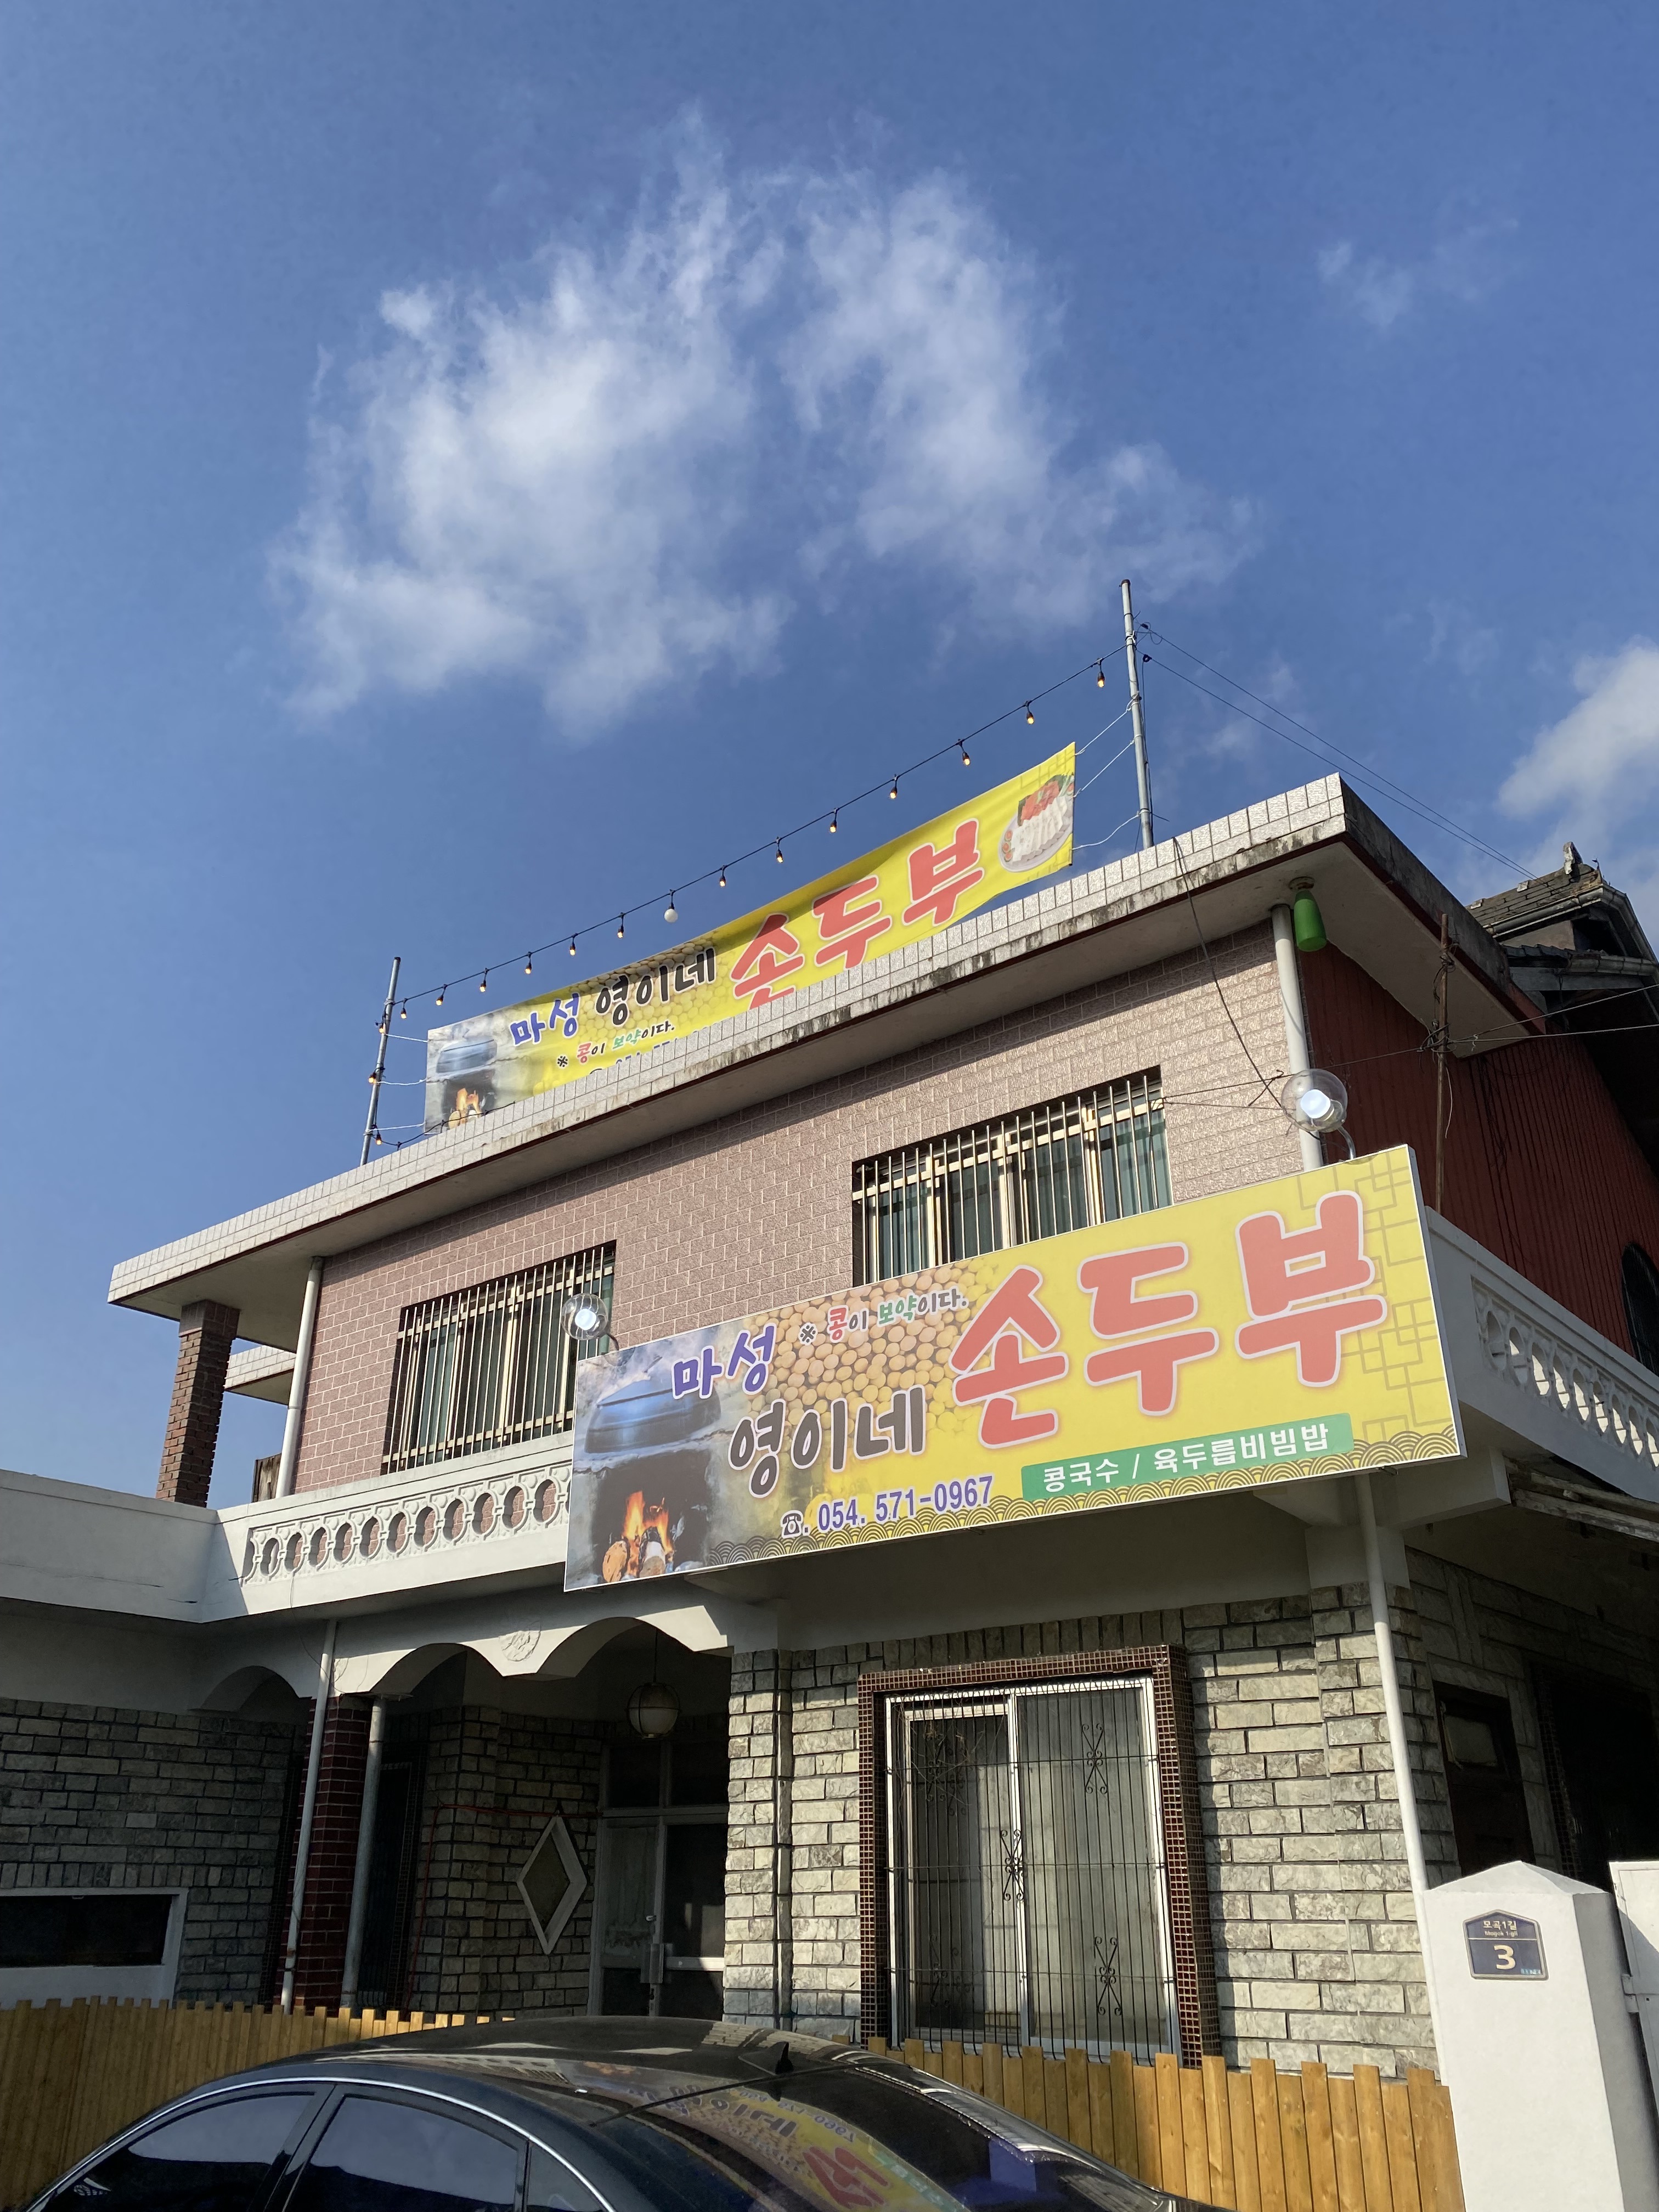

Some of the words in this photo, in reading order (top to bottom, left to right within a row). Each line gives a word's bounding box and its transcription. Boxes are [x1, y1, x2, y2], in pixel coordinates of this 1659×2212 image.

[510, 997, 579, 1046] 마성
[595, 947, 715, 1026] 영이네
[731, 820, 984, 1010] 손두부
[577, 1043, 605, 1063] 콩이
[613, 1021, 674, 1049] 보약이다.
[730, 1387, 924, 1496] 영이네
[953, 1192, 1386, 1447] 손두부
[828, 1307, 867, 1340] 콩이
[879, 1289, 967, 1323] 보약이다.
[674, 1326, 774, 1397] 마성
[1043, 1459, 1119, 1493] 콩국수
[1154, 1423, 1329, 1472] 육두릅비빔밥
[877, 1476, 992, 1521] 571-0967
[1493, 1944, 1516, 1970] 3
